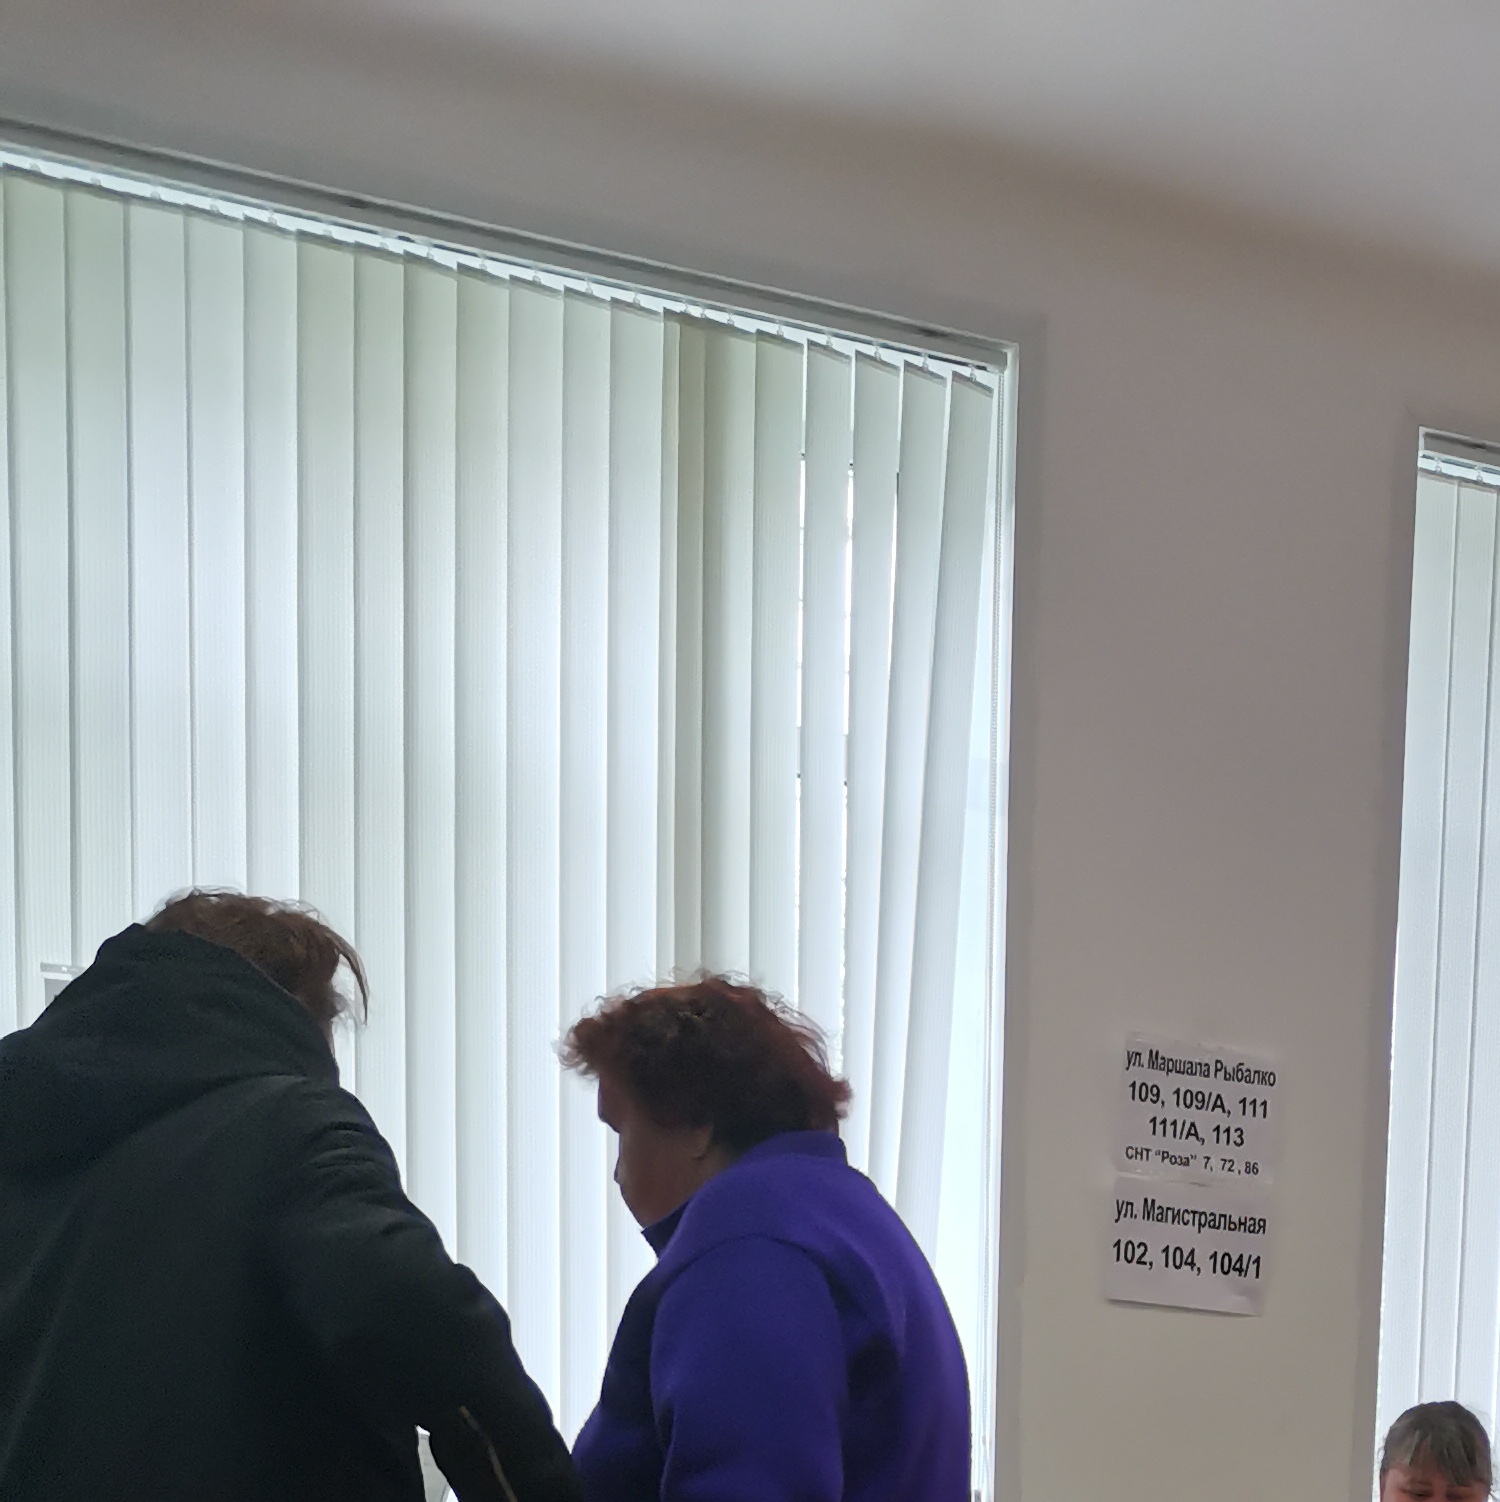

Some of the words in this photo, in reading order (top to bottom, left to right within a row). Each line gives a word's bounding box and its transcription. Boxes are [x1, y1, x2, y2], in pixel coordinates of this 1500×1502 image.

[1125, 1049, 1144, 1071] ул.
[1148, 1048, 1211, 1079] Маршала
[1214, 1059, 1277, 1087] Рыбалко
[1128, 1080, 1165, 1109] 109,
[1172, 1087, 1232, 1117] 109/А,
[1238, 1097, 1269, 1119] 111
[1148, 1116, 1206, 1146] 111/А,
[1212, 1124, 1245, 1148] 113
[1125, 1145, 1152, 1162] СНТ
[1244, 1160, 1259, 1176] 86
[1114, 1198, 1138, 1223] ул.
[1142, 1197, 1267, 1235] Магистральная
[1112, 1238, 1154, 1271] 102,
[1160, 1245, 1202, 1276] 104,
[1208, 1250, 1262, 1279] 104/1
